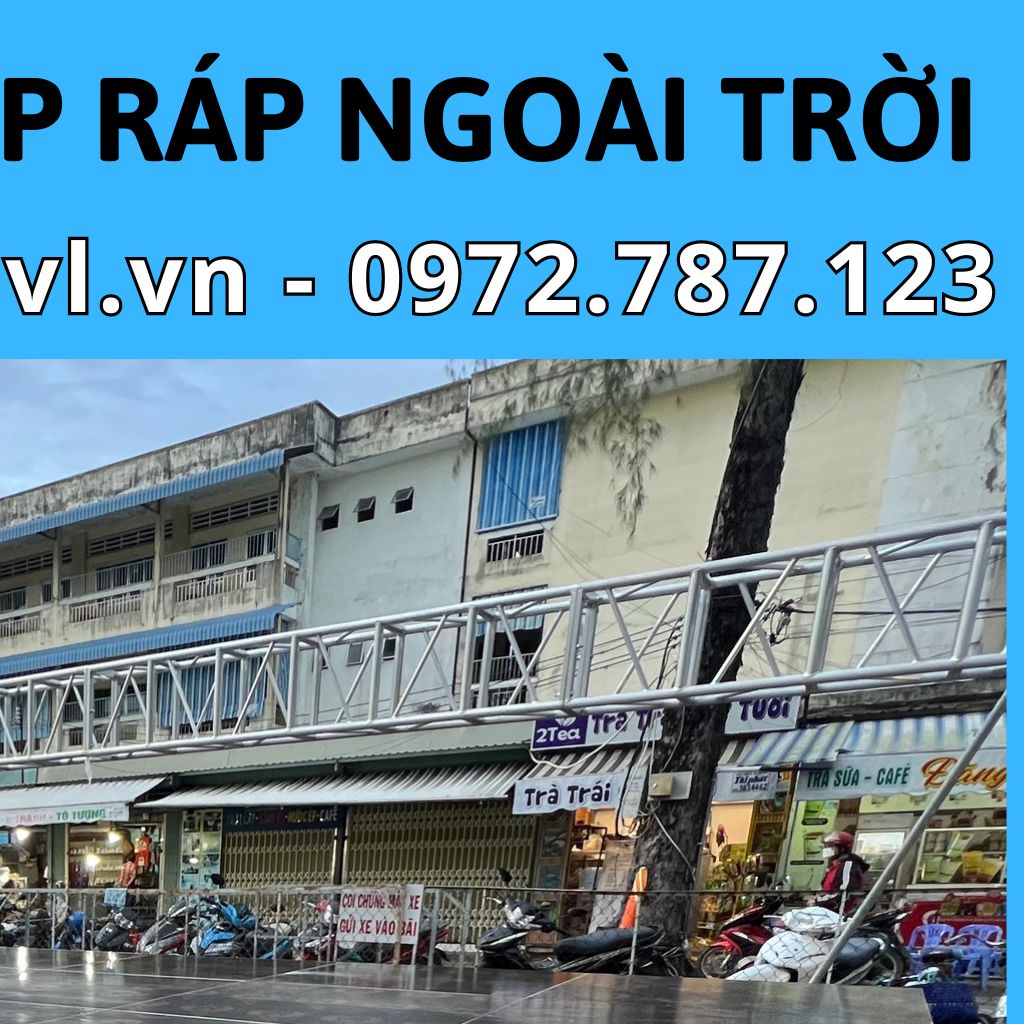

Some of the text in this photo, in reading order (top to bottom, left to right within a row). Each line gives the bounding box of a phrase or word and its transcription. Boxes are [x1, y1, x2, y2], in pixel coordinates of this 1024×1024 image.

[536, 726, 581, 743] 2Tea
[834, 765, 860, 788] SỮA
[525, 784, 559, 806] Trà
[567, 780, 611, 804] Trái
[342, 893, 355, 908] COI
[408, 895, 421, 910] XE
[359, 919, 372, 934] XE
[375, 916, 396, 936] VÀO
